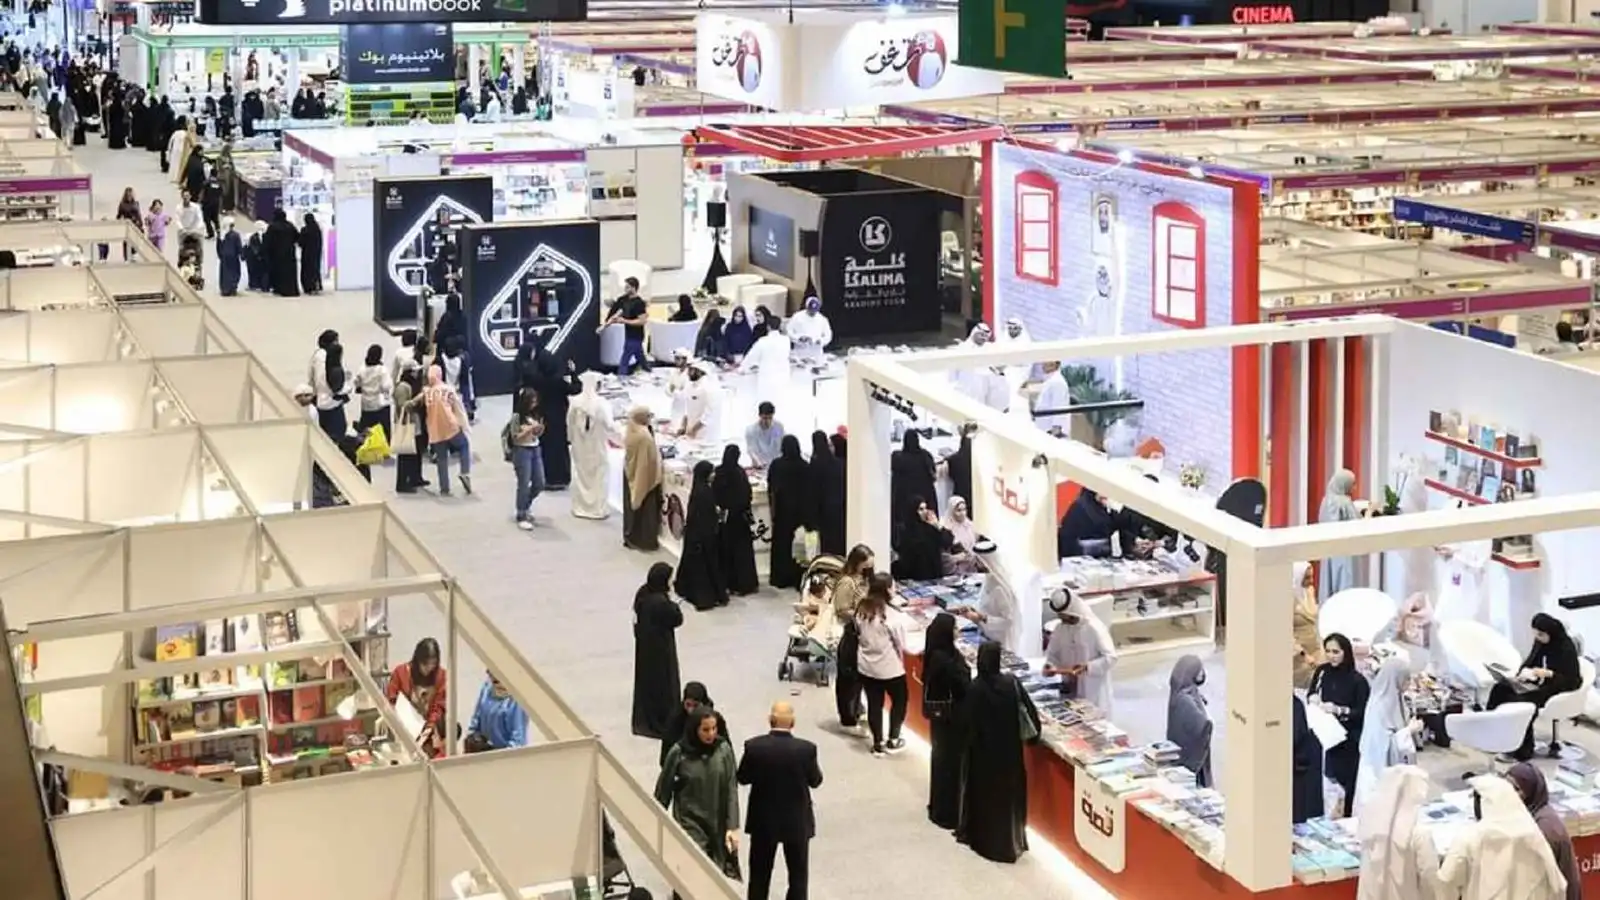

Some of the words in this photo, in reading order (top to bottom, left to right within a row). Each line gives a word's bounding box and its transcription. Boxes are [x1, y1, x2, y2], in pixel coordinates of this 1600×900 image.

[1232, 6, 1294, 24] CINEMA
[358, 50, 384, 64] بوك
[844, 253, 906, 271] كلمة
[844, 272, 905, 287] KALIMA
